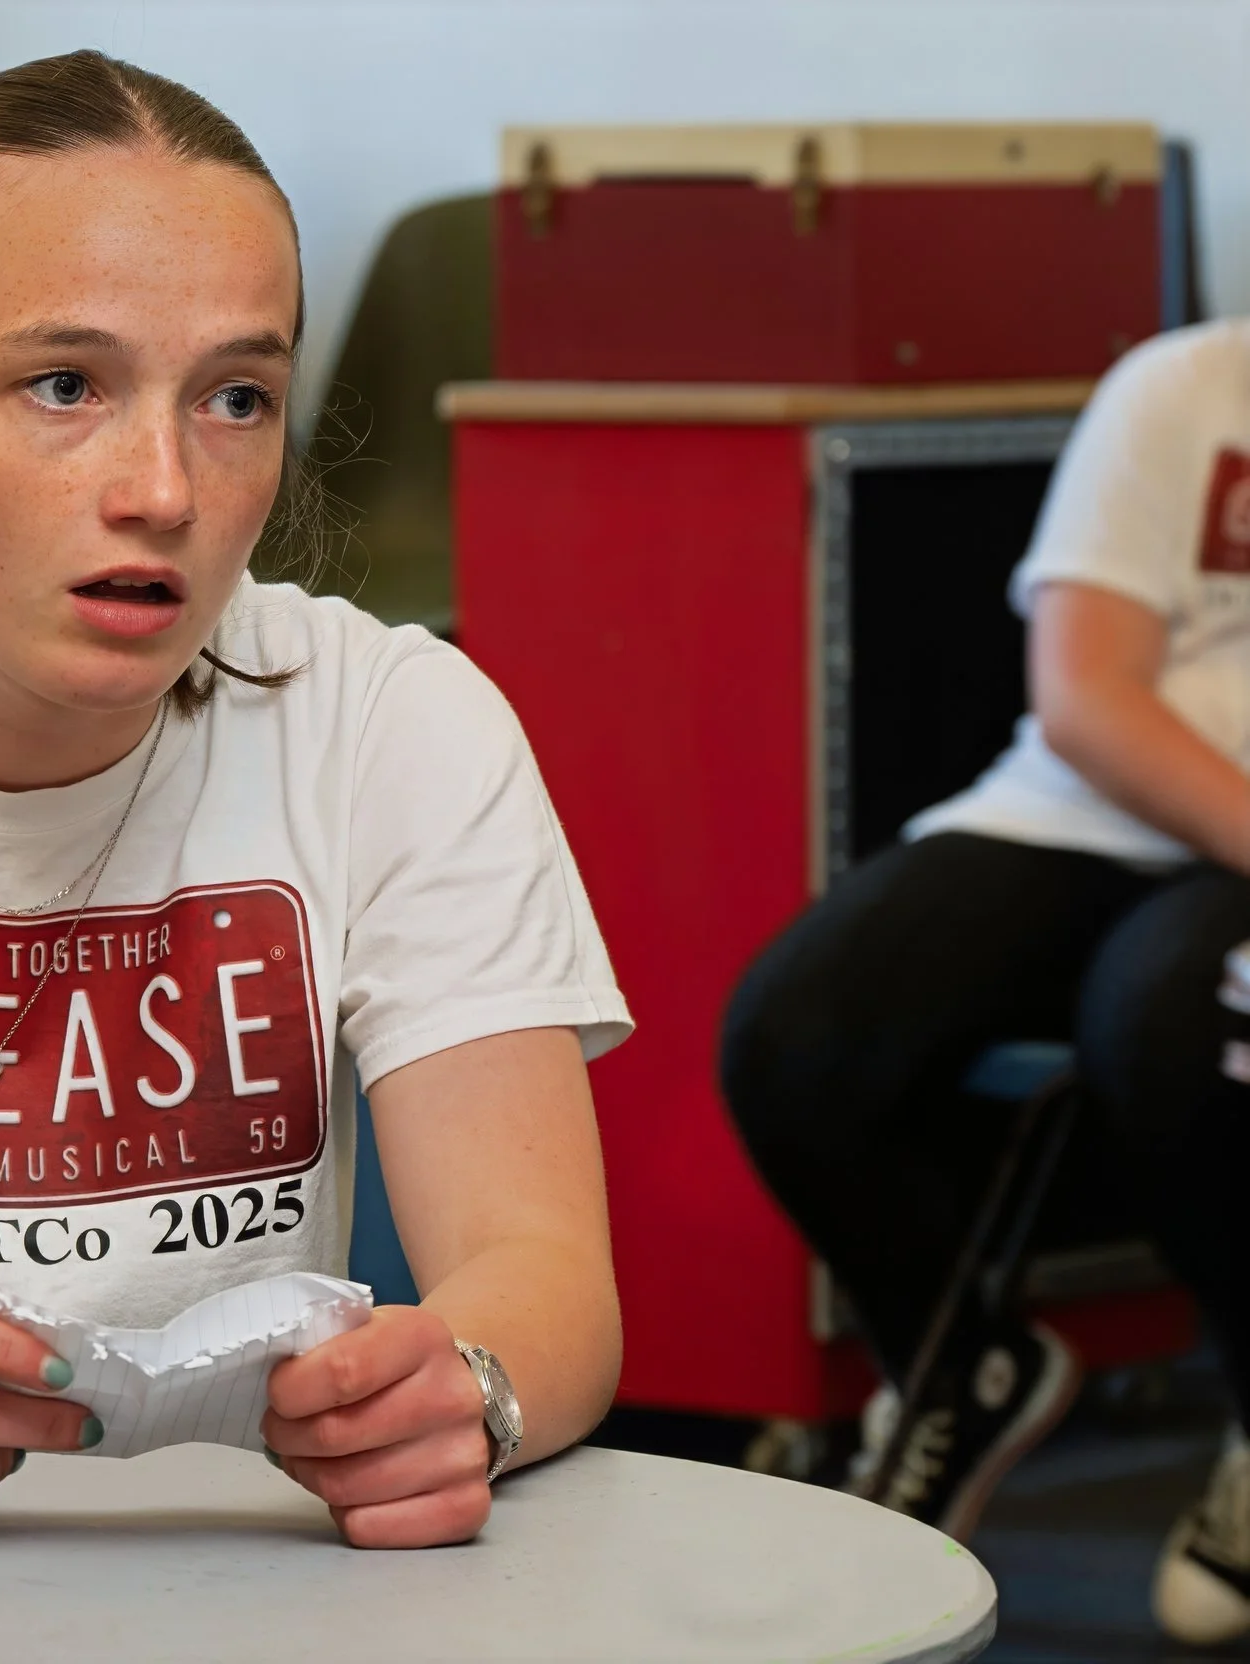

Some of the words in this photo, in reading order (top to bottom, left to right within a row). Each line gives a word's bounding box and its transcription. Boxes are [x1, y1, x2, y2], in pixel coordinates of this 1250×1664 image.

[7, 922, 171, 979] TOGETHER
[249, 1116, 287, 1155] 59
[149, 1178, 305, 1255] 2025
